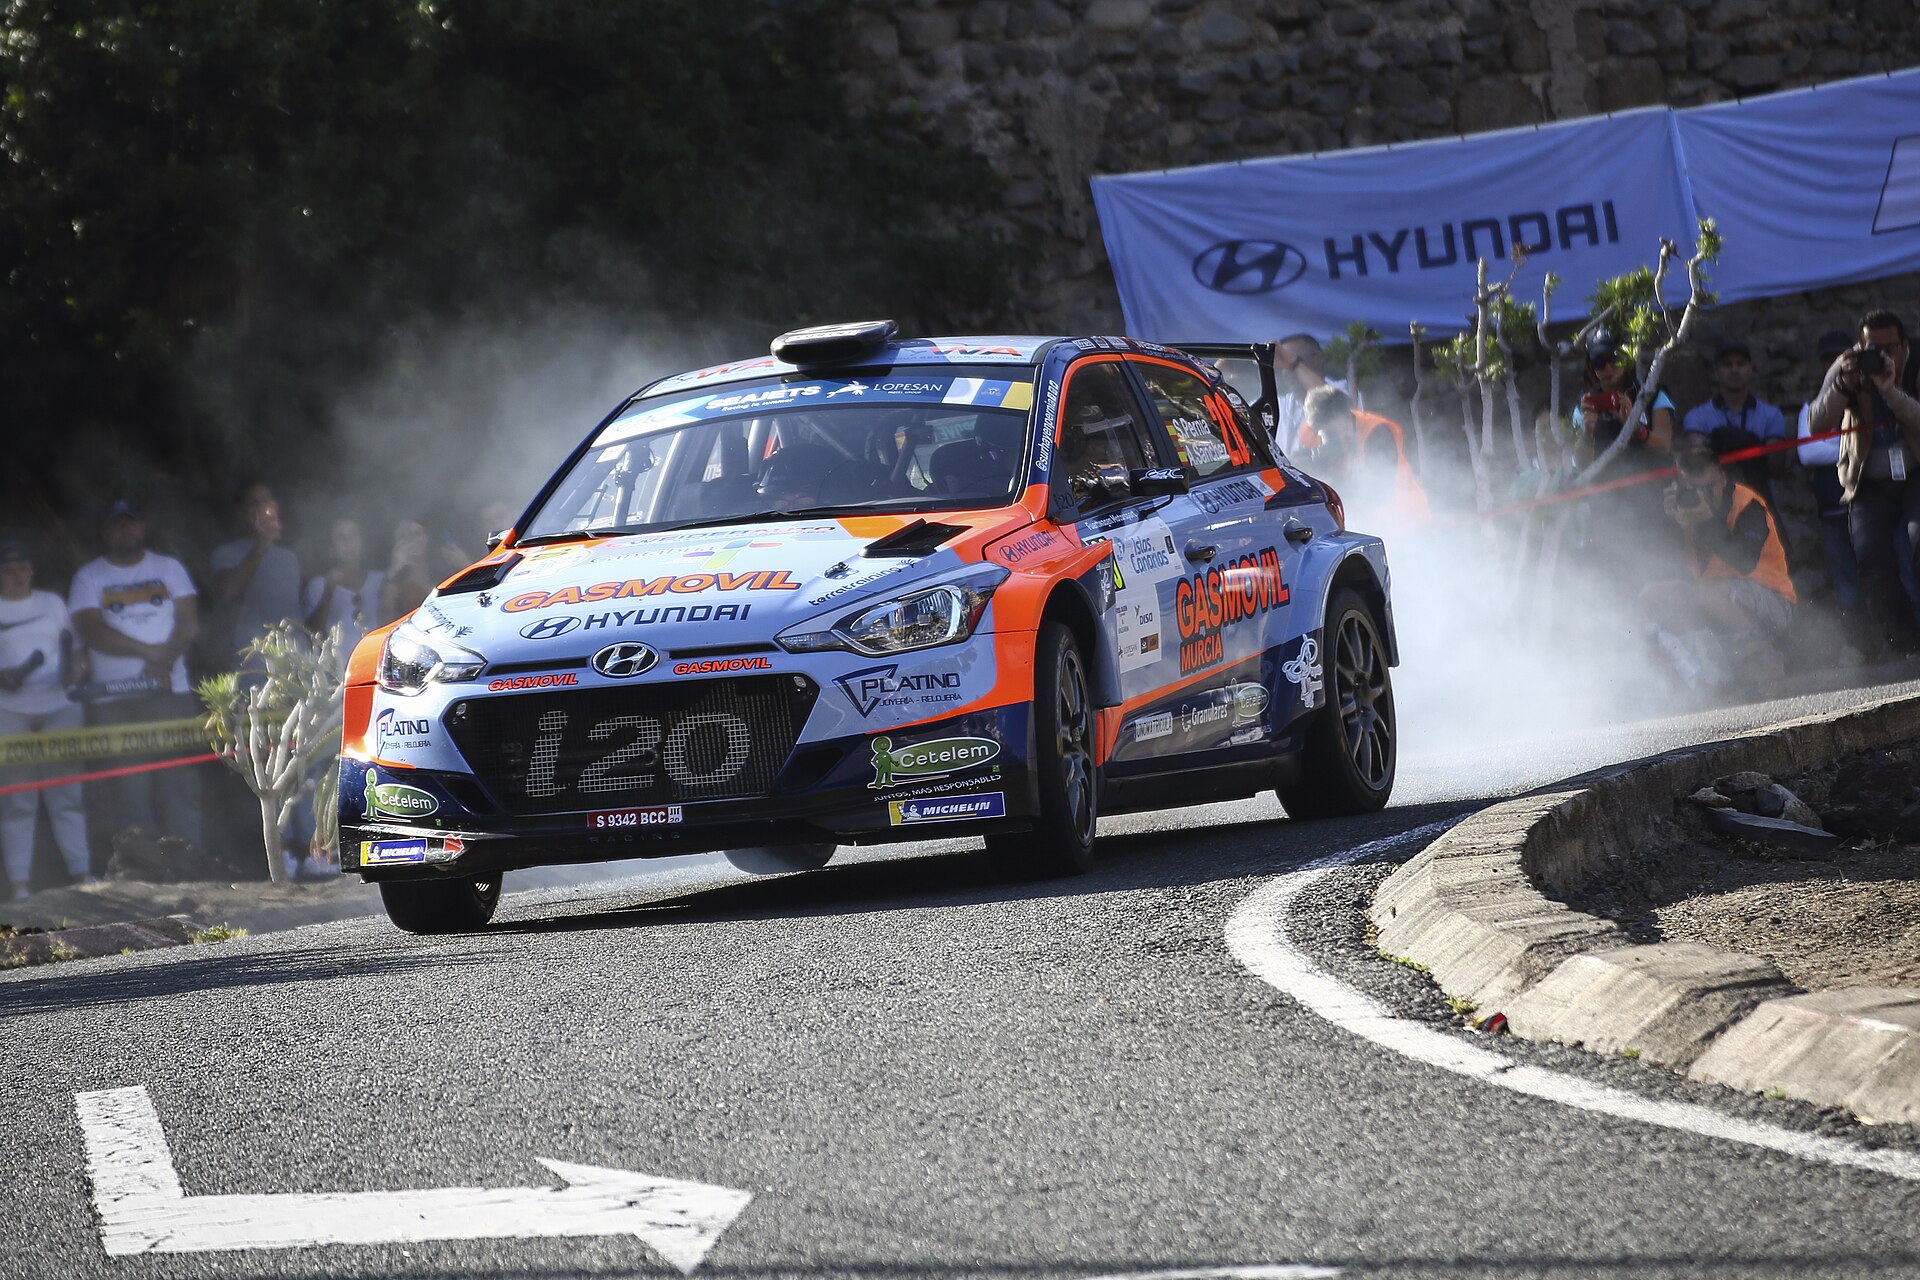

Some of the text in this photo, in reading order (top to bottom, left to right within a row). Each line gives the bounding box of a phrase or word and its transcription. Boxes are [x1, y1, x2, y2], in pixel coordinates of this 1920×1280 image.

[1323, 200, 1619, 280] HYUNDAI
[705, 386, 821, 410] SEAJETS
[873, 382, 943, 391] LOPESAN
[1207, 480, 1264, 508] HYUNDAI
[1013, 530, 1058, 557] HYUNDAI
[1132, 536, 1152, 556] Islas
[1130, 548, 1170, 575] Canarias
[500, 570, 801, 613] GASMOVIL
[808, 567, 902, 606] terratraining
[1177, 546, 1290, 640] GASMOVIL
[584, 604, 752, 630] HYUNDAI
[1180, 632, 1223, 674] MURCIA
[673, 657, 772, 676] GASMOVIL
[488, 674, 579, 692] GASMOVIL
[860, 672, 961, 701] PLATINO
[1192, 704, 1228, 725] Granulares
[120, 731, 158, 749] ZONA
[380, 719, 430, 744] PLATINO
[5, 733, 110, 762] ZONA PUBLICO
[526, 710, 750, 797] i20
[900, 743, 989, 768] Cetelem
[933, 774, 1002, 792] RESPONSABLES
[380, 791, 432, 809] Cetelem
[922, 802, 990, 815] MICHELIN
[596, 811, 666, 828] S 9342 BCC
[380, 846, 421, 857] MICHELIN
